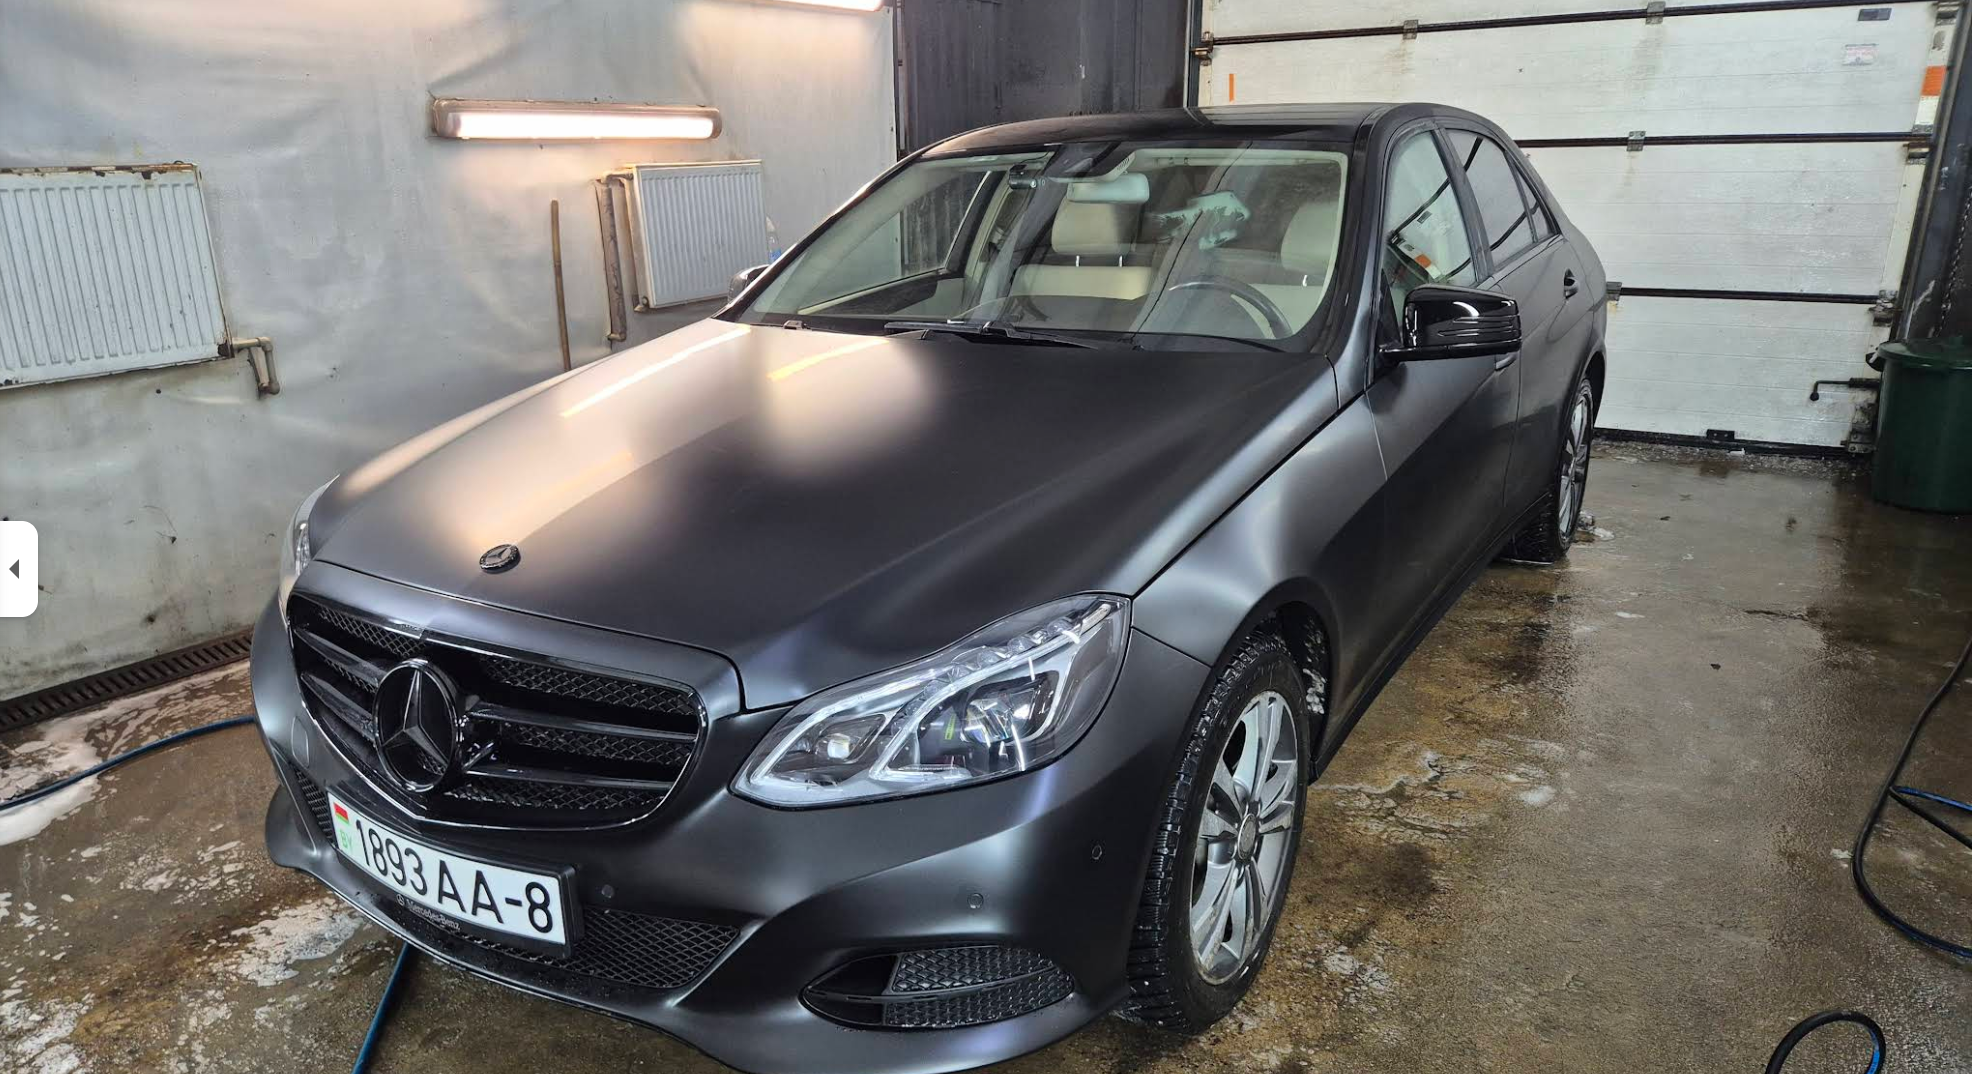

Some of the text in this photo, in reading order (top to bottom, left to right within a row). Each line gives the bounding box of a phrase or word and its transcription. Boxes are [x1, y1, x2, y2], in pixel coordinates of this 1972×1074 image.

[339, 829, 353, 851] BY
[356, 819, 553, 933] 1893 AA-8
